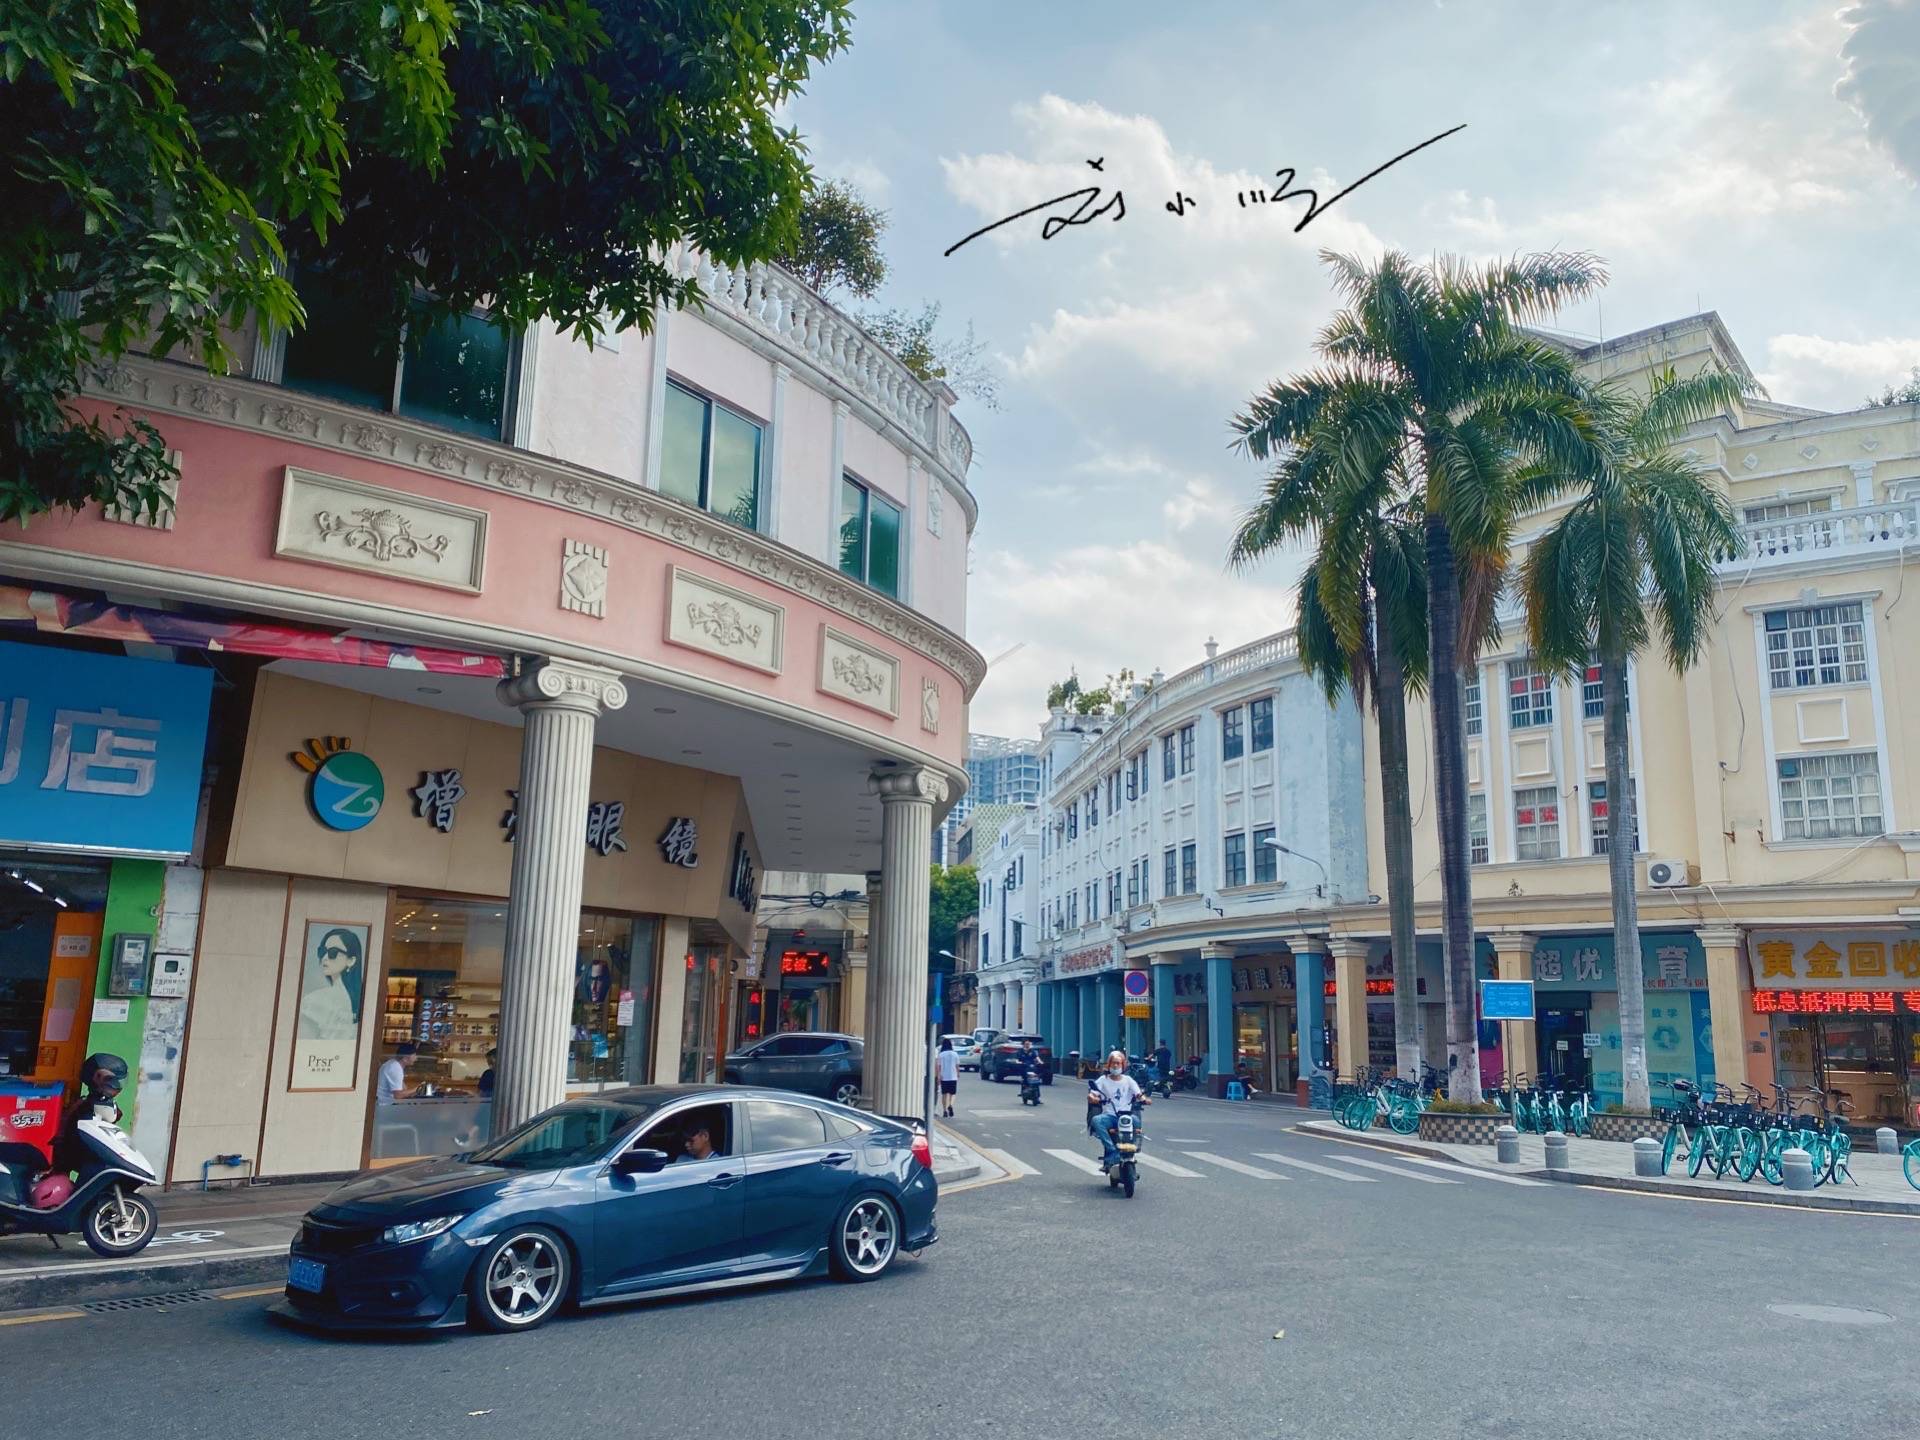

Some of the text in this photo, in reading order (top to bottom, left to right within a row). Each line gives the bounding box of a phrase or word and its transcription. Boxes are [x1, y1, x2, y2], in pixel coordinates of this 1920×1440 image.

[411, 768, 699, 868] 增眼镜
[1535, 946, 1689, 981] 超优育
[1757, 940, 1920, 979] 黄金回收
[1753, 991, 1894, 1012] 低息抵押典当
